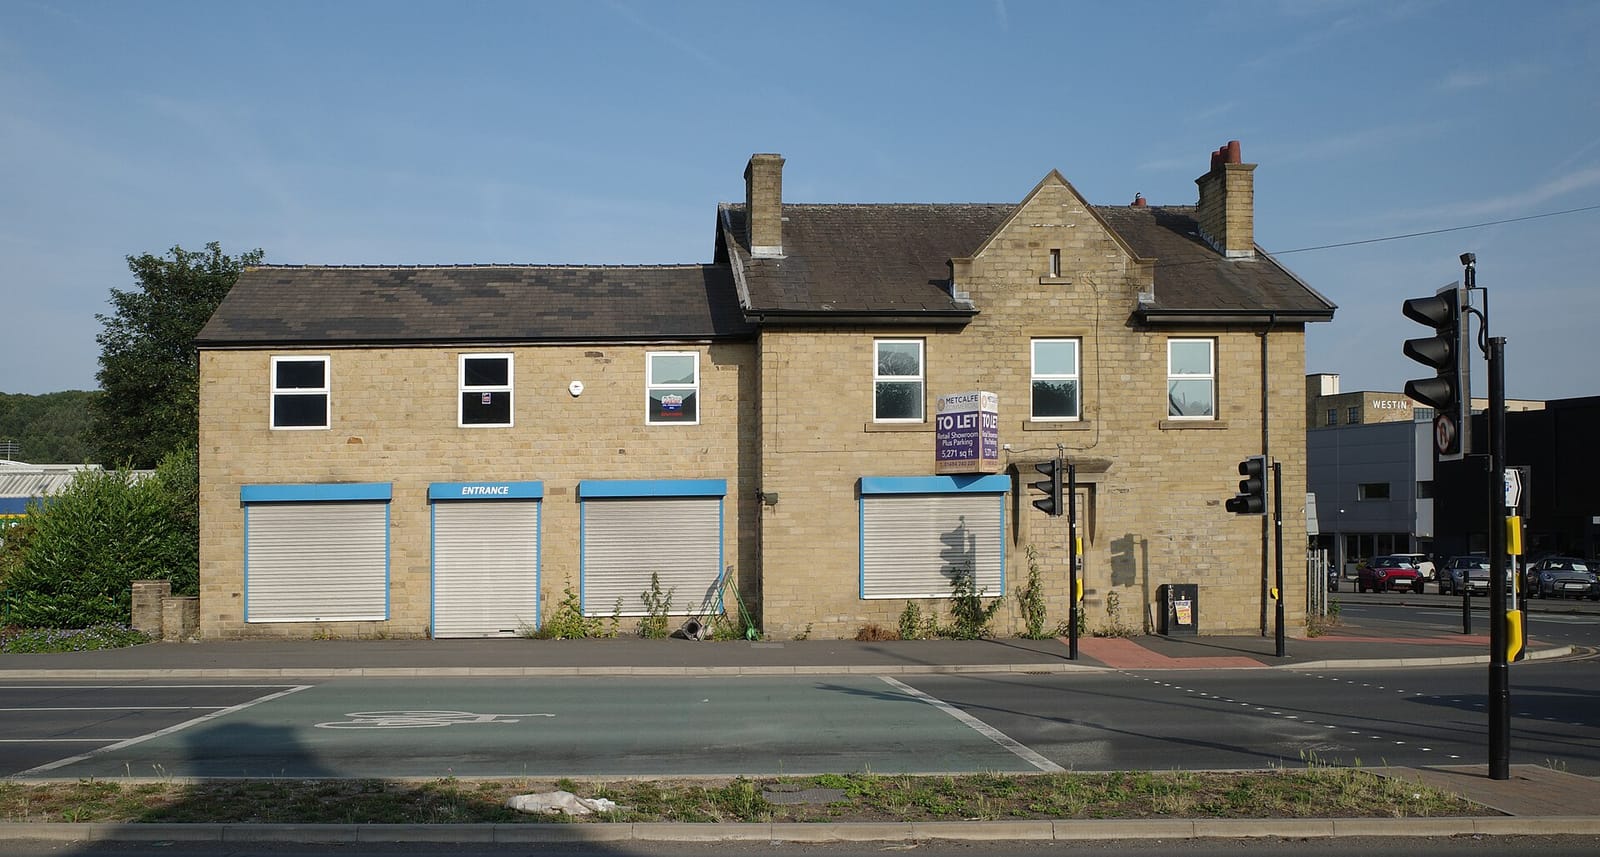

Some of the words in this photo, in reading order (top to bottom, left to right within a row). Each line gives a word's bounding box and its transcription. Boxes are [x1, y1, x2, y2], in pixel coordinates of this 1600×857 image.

[946, 395, 978, 404] METCALFE
[1372, 399, 1407, 409] WESTIN
[937, 415, 953, 430] TO
[957, 414, 978, 429] LET
[983, 414, 990, 428] TO
[953, 438, 973, 446] Parking
[942, 449, 957, 458] 5,271
[959, 450, 967, 458] sq
[968, 448, 973, 457] ft
[462, 486, 508, 495] ENTRANCE
